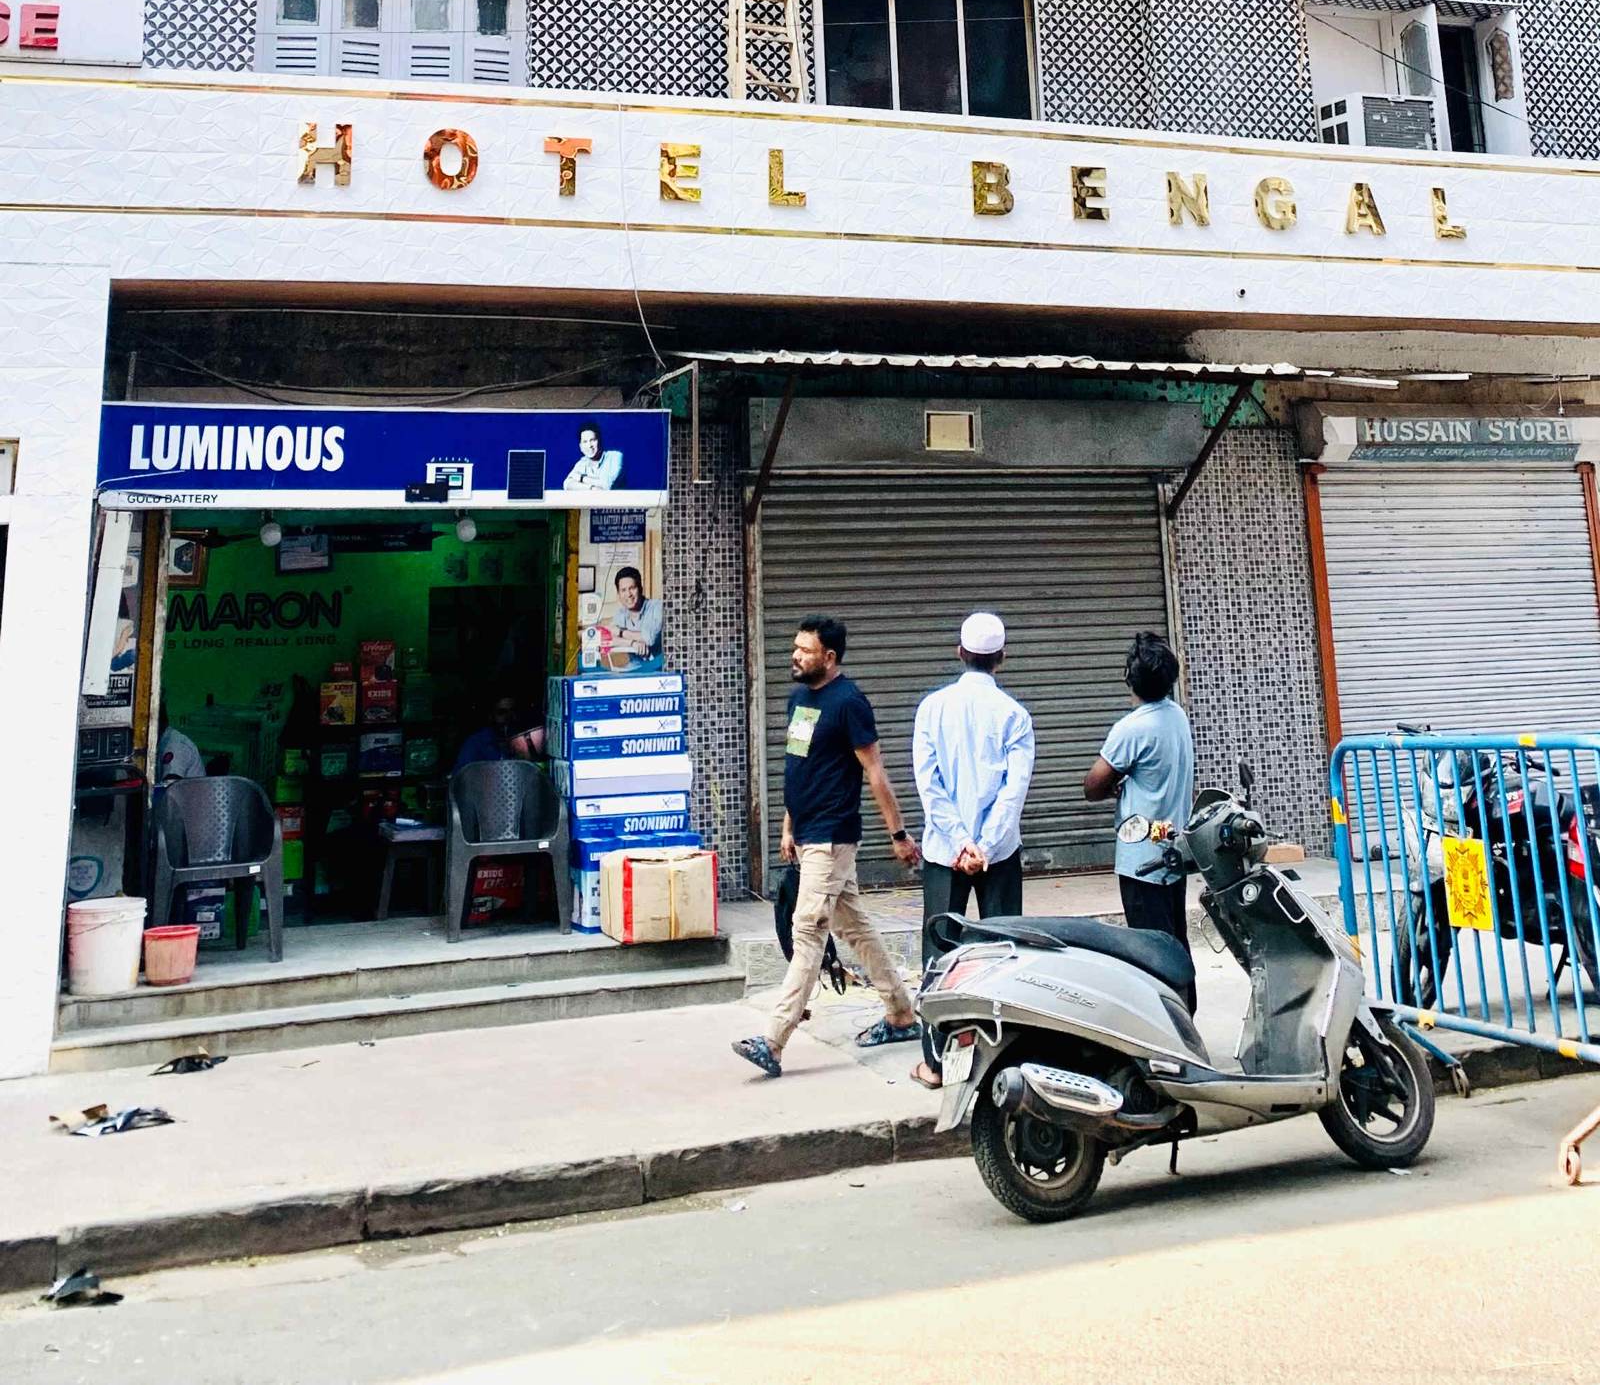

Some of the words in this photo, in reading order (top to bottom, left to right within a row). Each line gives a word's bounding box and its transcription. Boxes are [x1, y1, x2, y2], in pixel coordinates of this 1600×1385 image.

[297, 122, 807, 207] HOTEL
[971, 160, 1468, 239] BENGAL
[1364, 420, 1472, 443] HUSSAIN
[1488, 419, 1571, 442] STORE
[129, 424, 345, 473] LUMINOUS
[164, 493, 219, 504] BATTERY
[619, 696, 680, 714] LUMINOUS
[621, 736, 681, 755] LUMINOUS
[623, 814, 685, 833] LUMINOUS
